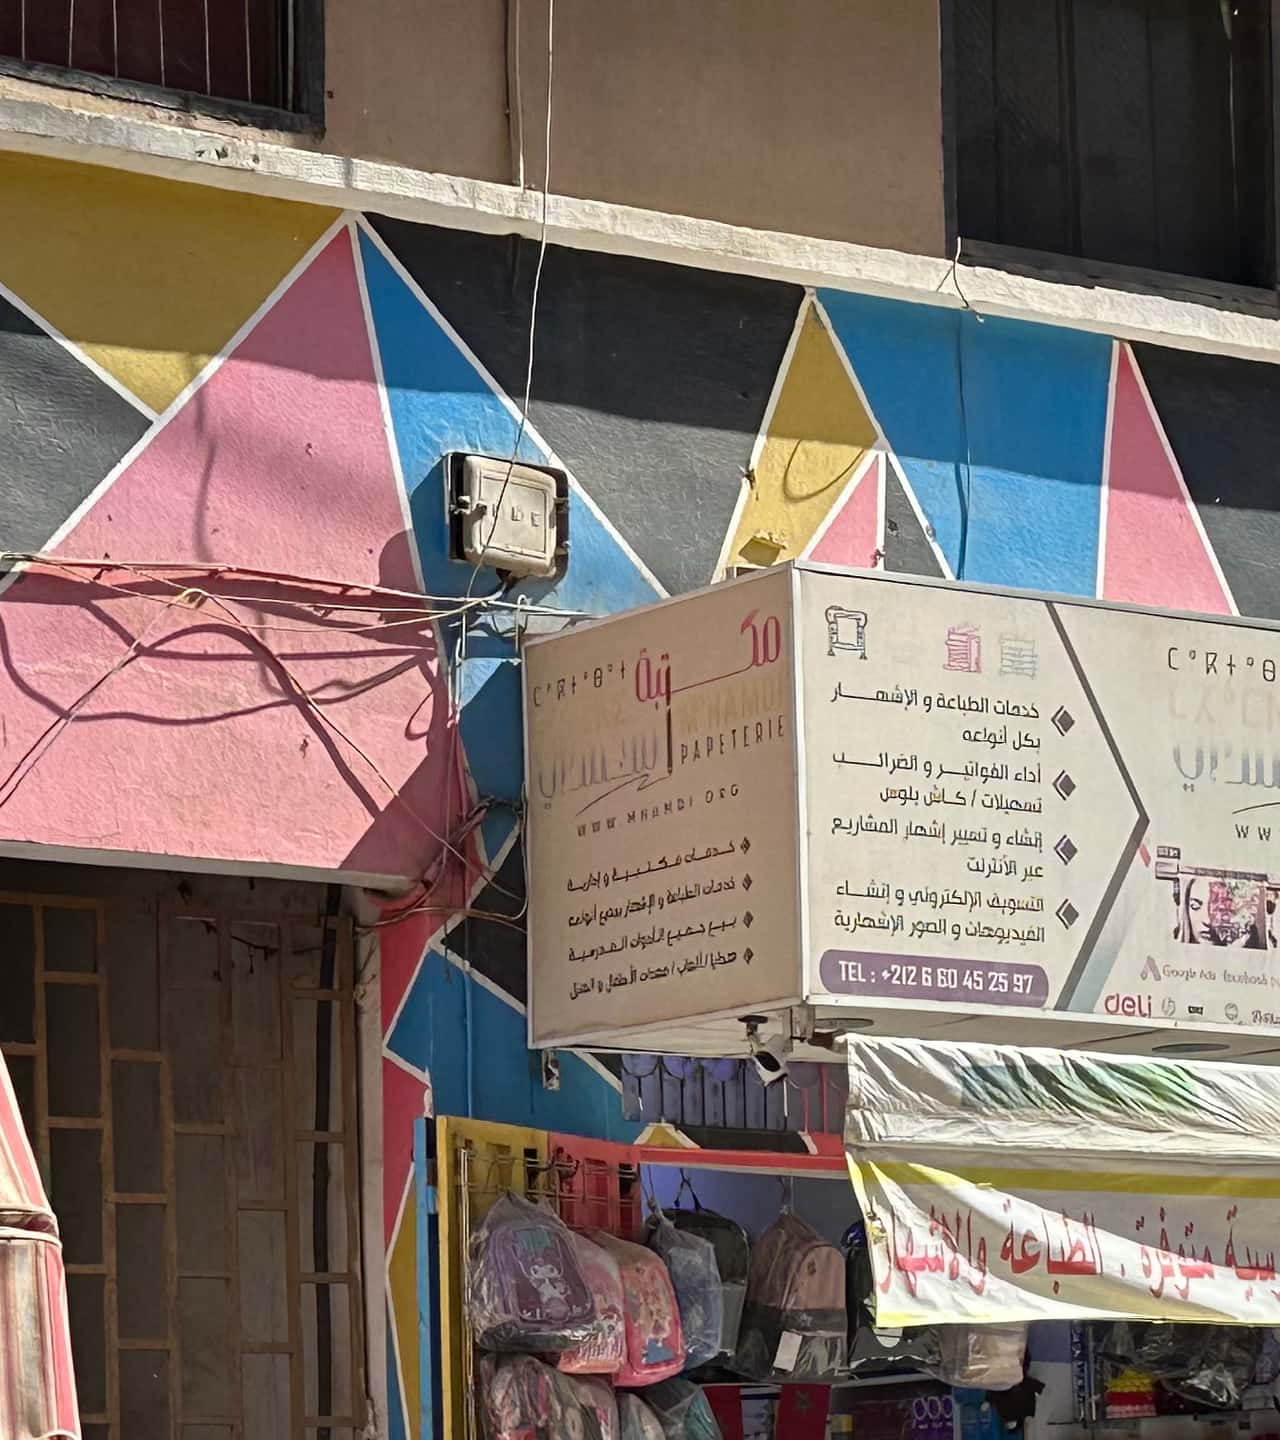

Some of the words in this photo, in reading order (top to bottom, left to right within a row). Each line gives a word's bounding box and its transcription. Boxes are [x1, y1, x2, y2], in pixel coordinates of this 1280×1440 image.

[923, 696, 932, 712] و
[937, 693, 988, 716] الطباعة
[993, 701, 1039, 719] خدمات
[681, 714, 784, 766] PAPETERIE
[963, 726, 1007, 749] أنواعه
[1012, 731, 1040, 754] بكل
[923, 761, 931, 778] و
[1015, 763, 1041, 783] أداء
[982, 793, 1042, 814] تسهيلات
[832, 814, 897, 835] المشاريع
[992, 832, 1001, 848] و
[1021, 863, 1044, 881] عبر
[895, 887, 904, 904] و
[908, 919, 946, 939] الصور
[952, 923, 961, 940] و
[839, 961, 866, 982] TEL
[882, 965, 917, 985] +212
[922, 967, 932, 986] 6
[937, 968, 957, 988] 60
[963, 970, 983, 989] 45
[988, 972, 1009, 992] 25
[1013, 974, 1033, 994] 97
[1104, 992, 1152, 1019] deli
[1000, 1200, 1104, 1295] الطباعة
